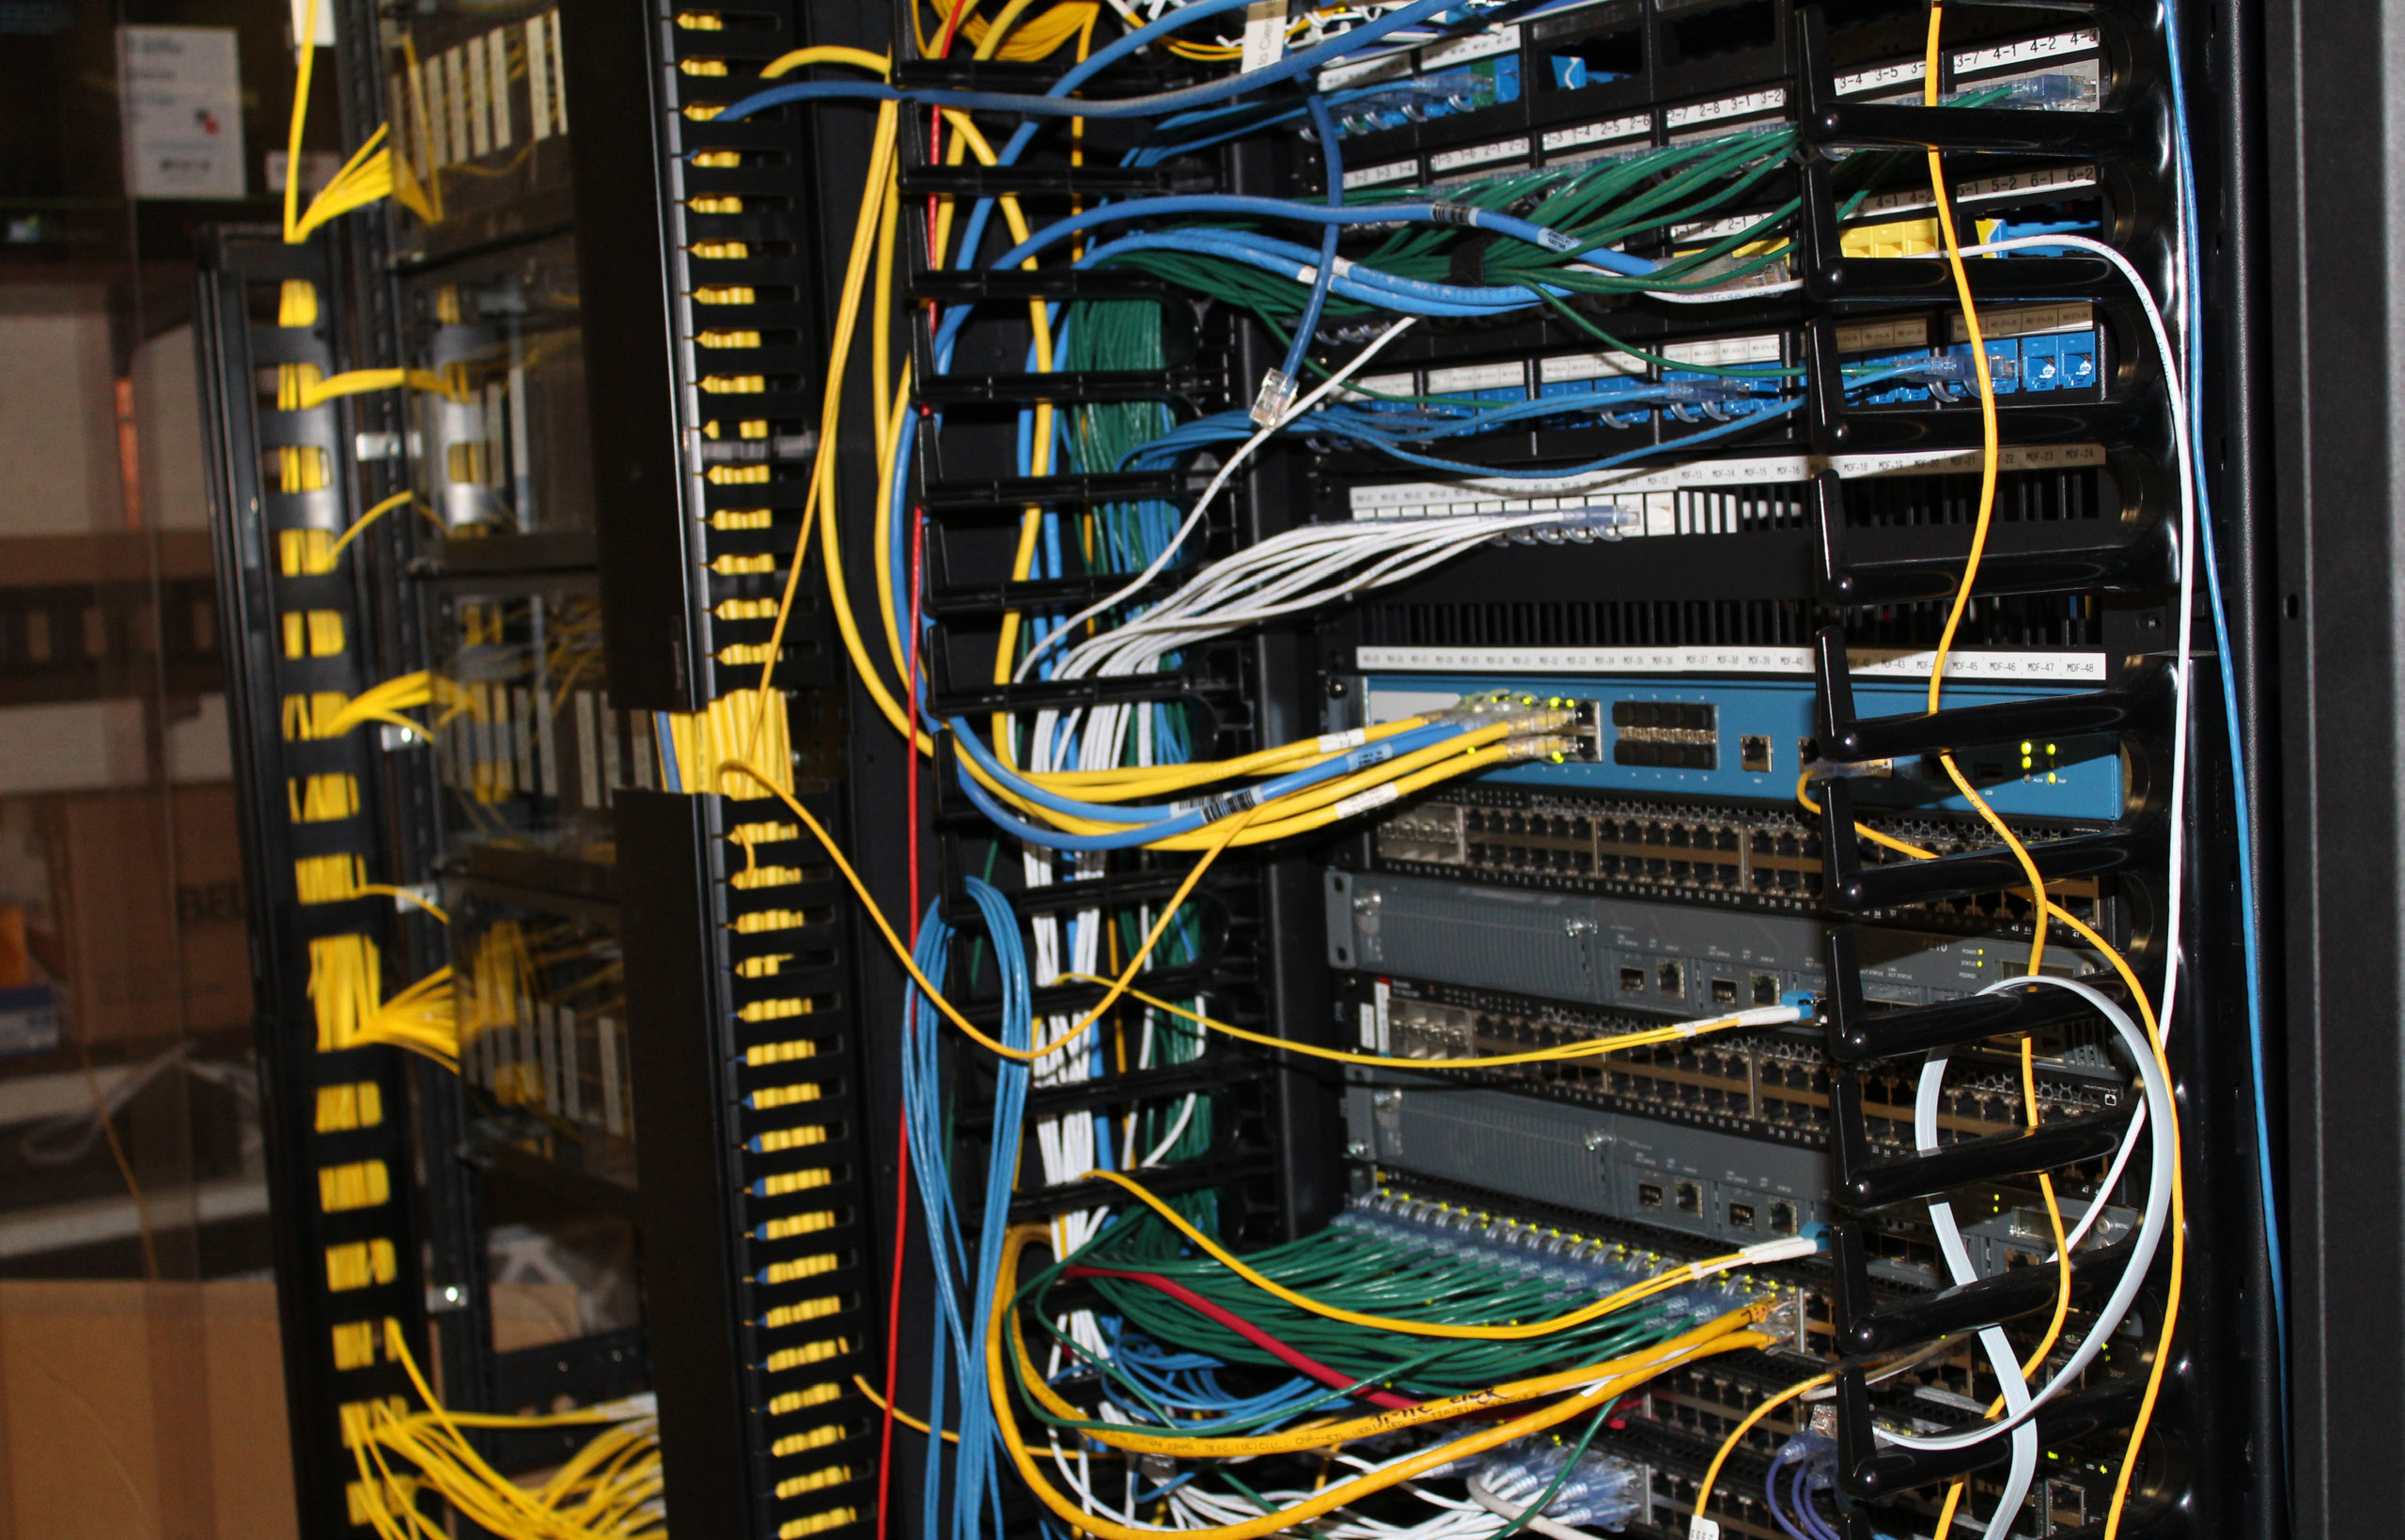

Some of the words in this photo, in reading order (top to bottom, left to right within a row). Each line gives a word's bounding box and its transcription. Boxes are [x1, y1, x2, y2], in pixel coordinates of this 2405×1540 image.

[1956, 52, 1980, 68] 3-7
[1993, 44, 2017, 60] 4-1
[2030, 37, 2056, 53] 4-2
[2070, 29, 2097, 45] 4-3
[1840, 74, 1863, 89] 3-4
[1876, 67, 1898, 81] 3-5
[1669, 107, 1689, 121] 2-7
[1699, 101, 1721, 117] 2-8
[1731, 95, 1751, 110] 3-1
[1761, 89, 1781, 104] 3-2
[1601, 121, 1620, 134] 2-5
[1630, 116, 1650, 130] 2-6
[1991, 178, 2018, 192] 5-2
[2031, 173, 2054, 185] 6-1
[2068, 168, 2094, 181] 6-2
[1877, 196, 1898, 209] 4-1
[1911, 191, 1934, 203] 4-2
[1728, 215, 1747, 230] 2-1
[1844, 462, 1868, 473] MDF-18
[1950, 456, 1976, 467] MDF-21
[2026, 452, 2054, 462] MDF-23
[2066, 449, 2094, 459] MDF-24
[1681, 471, 1703, 480] MDF-13
[1712, 468, 1735, 478] MDF-14
[1744, 466, 1768, 476] MDF-15
[1776, 464, 1801, 475] MDF-16
[1686, 655, 1709, 665] MDF-37
[1717, 655, 1739, 665] MDF-38
[1748, 655, 1771, 665] MDF-39
[1780, 655, 1804, 666] MDF-40
[1953, 661, 1978, 671] MDF-45
[1990, 661, 2016, 672] MDF-46
[2028, 662, 2054, 673] MDF-47
[2067, 662, 2094, 673] MDF-48
